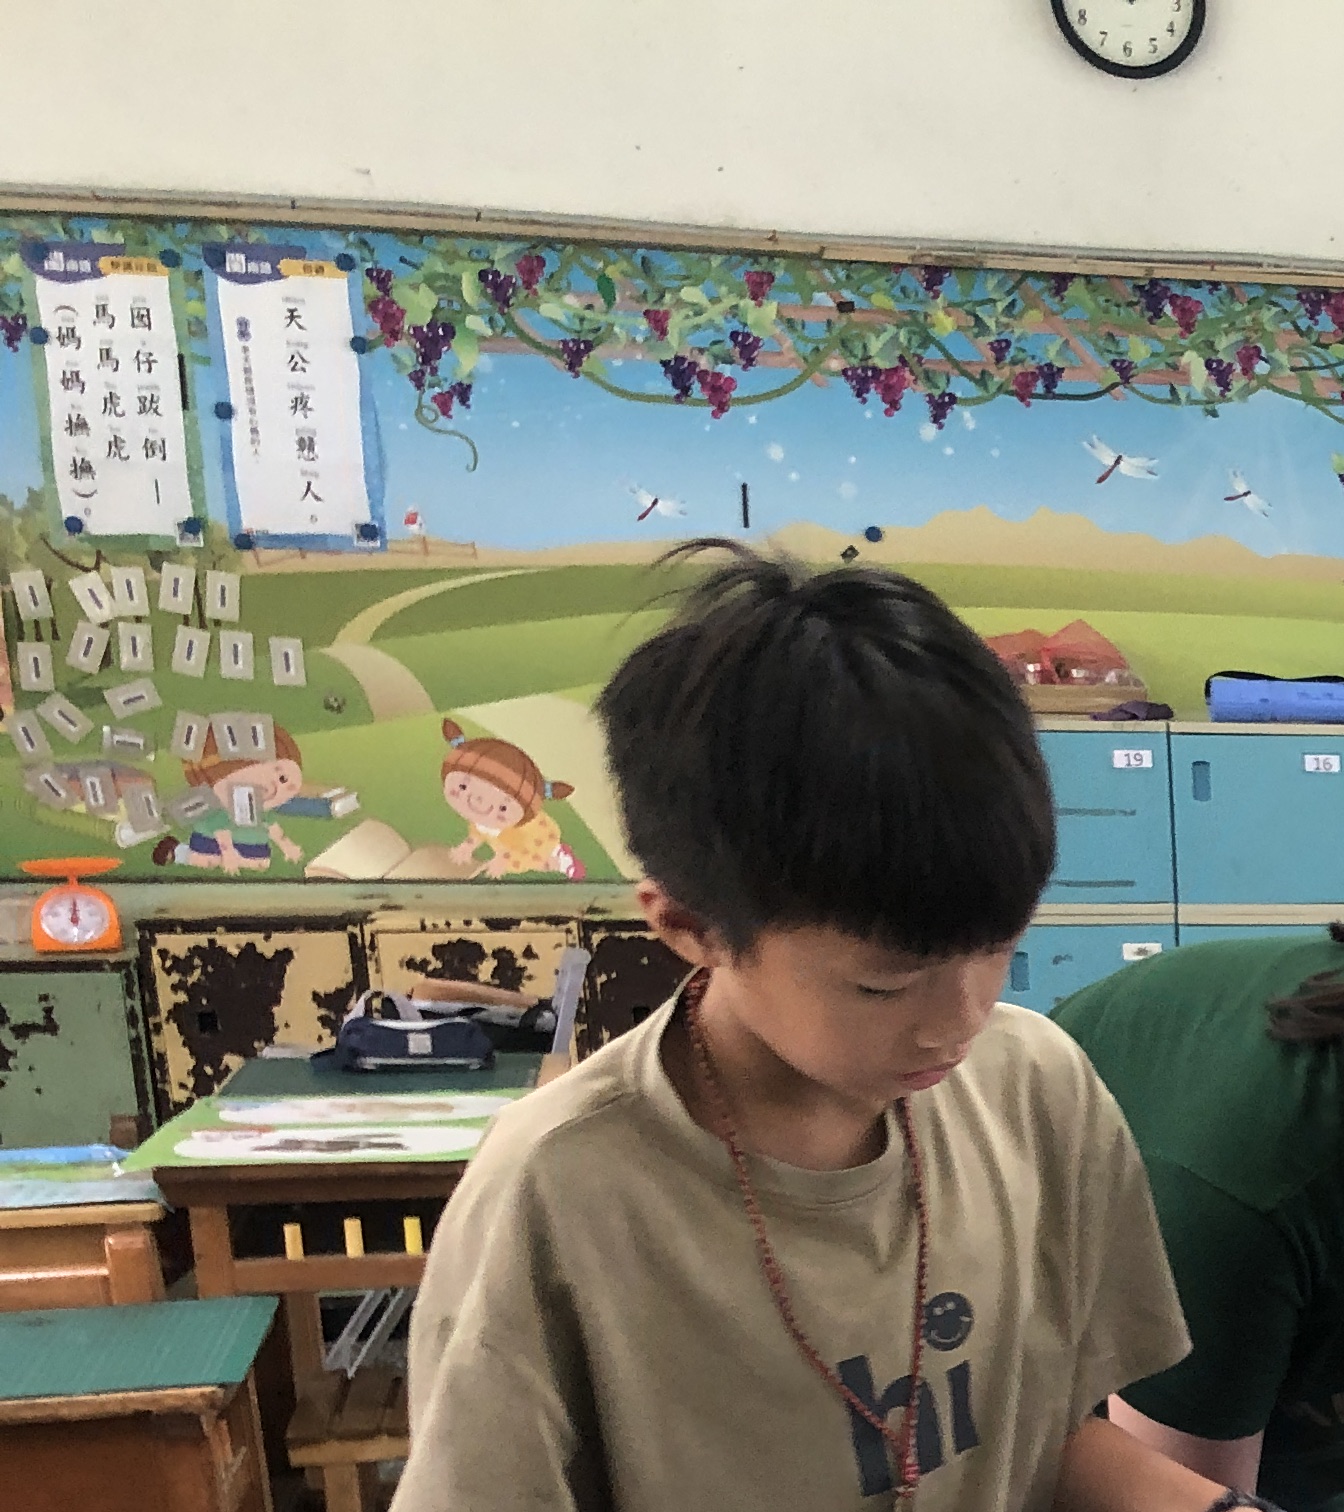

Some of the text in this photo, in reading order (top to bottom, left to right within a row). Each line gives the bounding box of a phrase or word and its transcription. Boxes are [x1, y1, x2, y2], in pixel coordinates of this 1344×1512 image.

[1077, 8, 1088, 26] 8
[1166, 20, 1175, 37] 4
[1099, 30, 1108, 46] 7
[1149, 37, 1158, 54] 5
[1122, 40, 1133, 58] 6
[92, 302, 131, 463] 馬馬虎虎
[1123, 752, 1144, 767] 19
[1313, 757, 1333, 771] 16
[835, 1290, 982, 1498] hi
